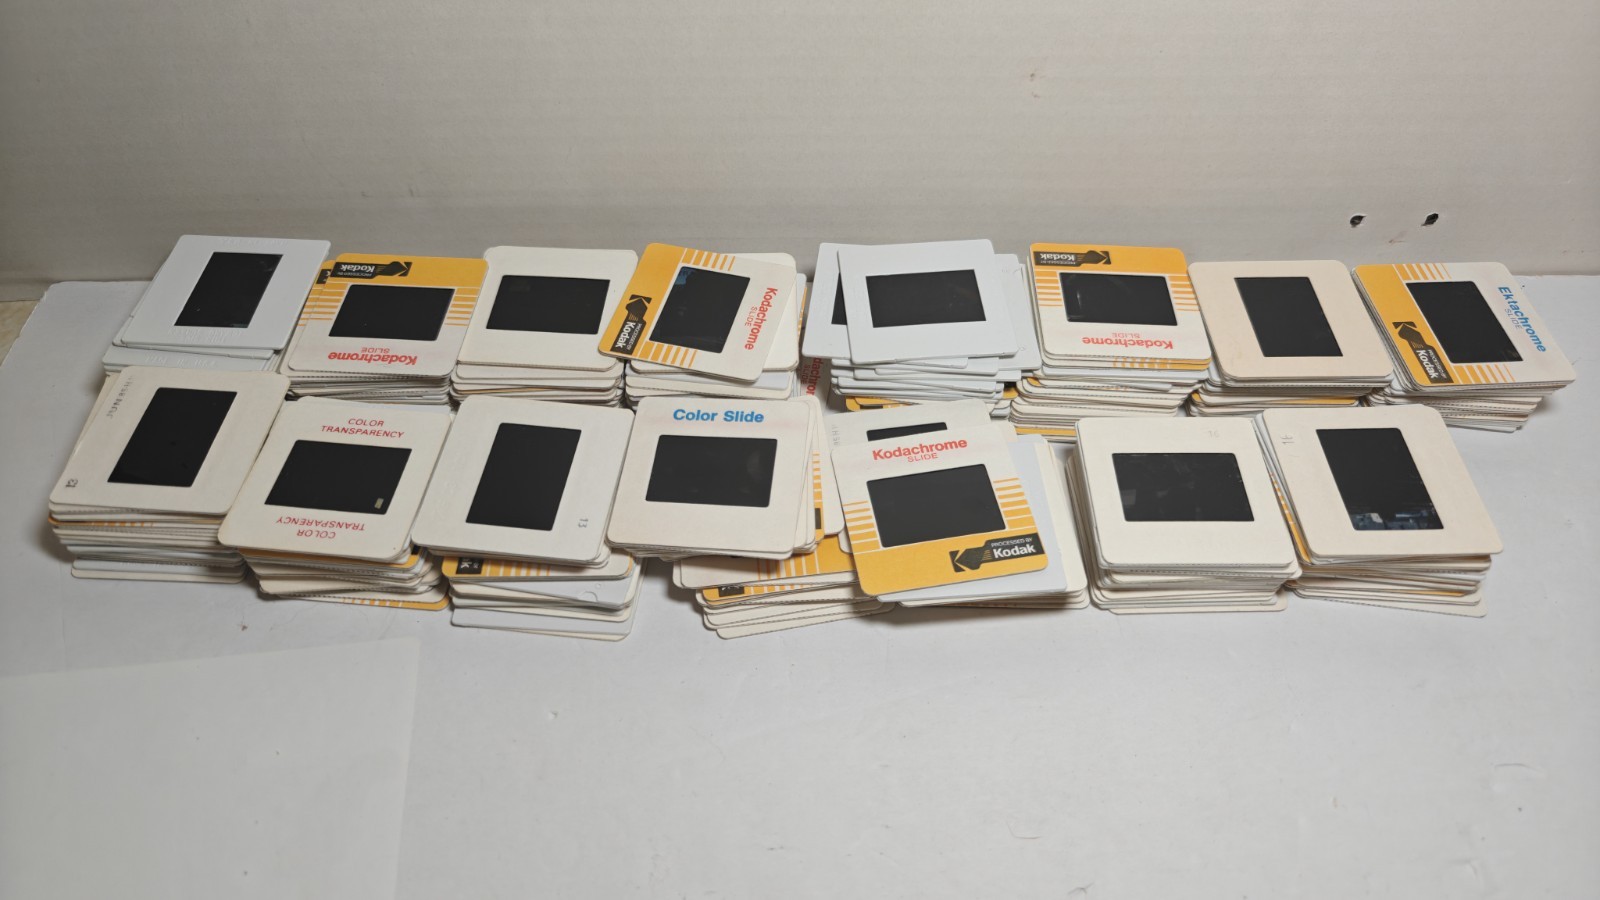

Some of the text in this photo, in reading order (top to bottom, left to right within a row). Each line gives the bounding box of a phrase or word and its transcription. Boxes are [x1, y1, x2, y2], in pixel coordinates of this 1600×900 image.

[1040, 253, 1075, 261] Kodak
[341, 264, 375, 273] Kodak
[744, 306, 758, 327] SLIDE
[744, 287, 778, 350] Kodachrome
[1498, 287, 1546, 352] Ektachrome
[1505, 308, 1523, 330] SLIDE
[615, 321, 637, 348] Kodak
[1082, 336, 1174, 349] Kodachrome
[328, 352, 418, 365] Kodachrome
[1416, 350, 1439, 379] Kodak
[348, 418, 384, 427] COLOR
[673, 409, 765, 423] Color Slide
[321, 425, 405, 438] TRANSPARENCY
[872, 439, 968, 460] Kodachrome
[907, 453, 939, 463] SLIDE
[276, 516, 365, 531] TRANSPARENCY
[296, 529, 336, 539] COLOR
[991, 538, 1026, 548] PROCESSED
[993, 544, 1036, 559] Kodak
